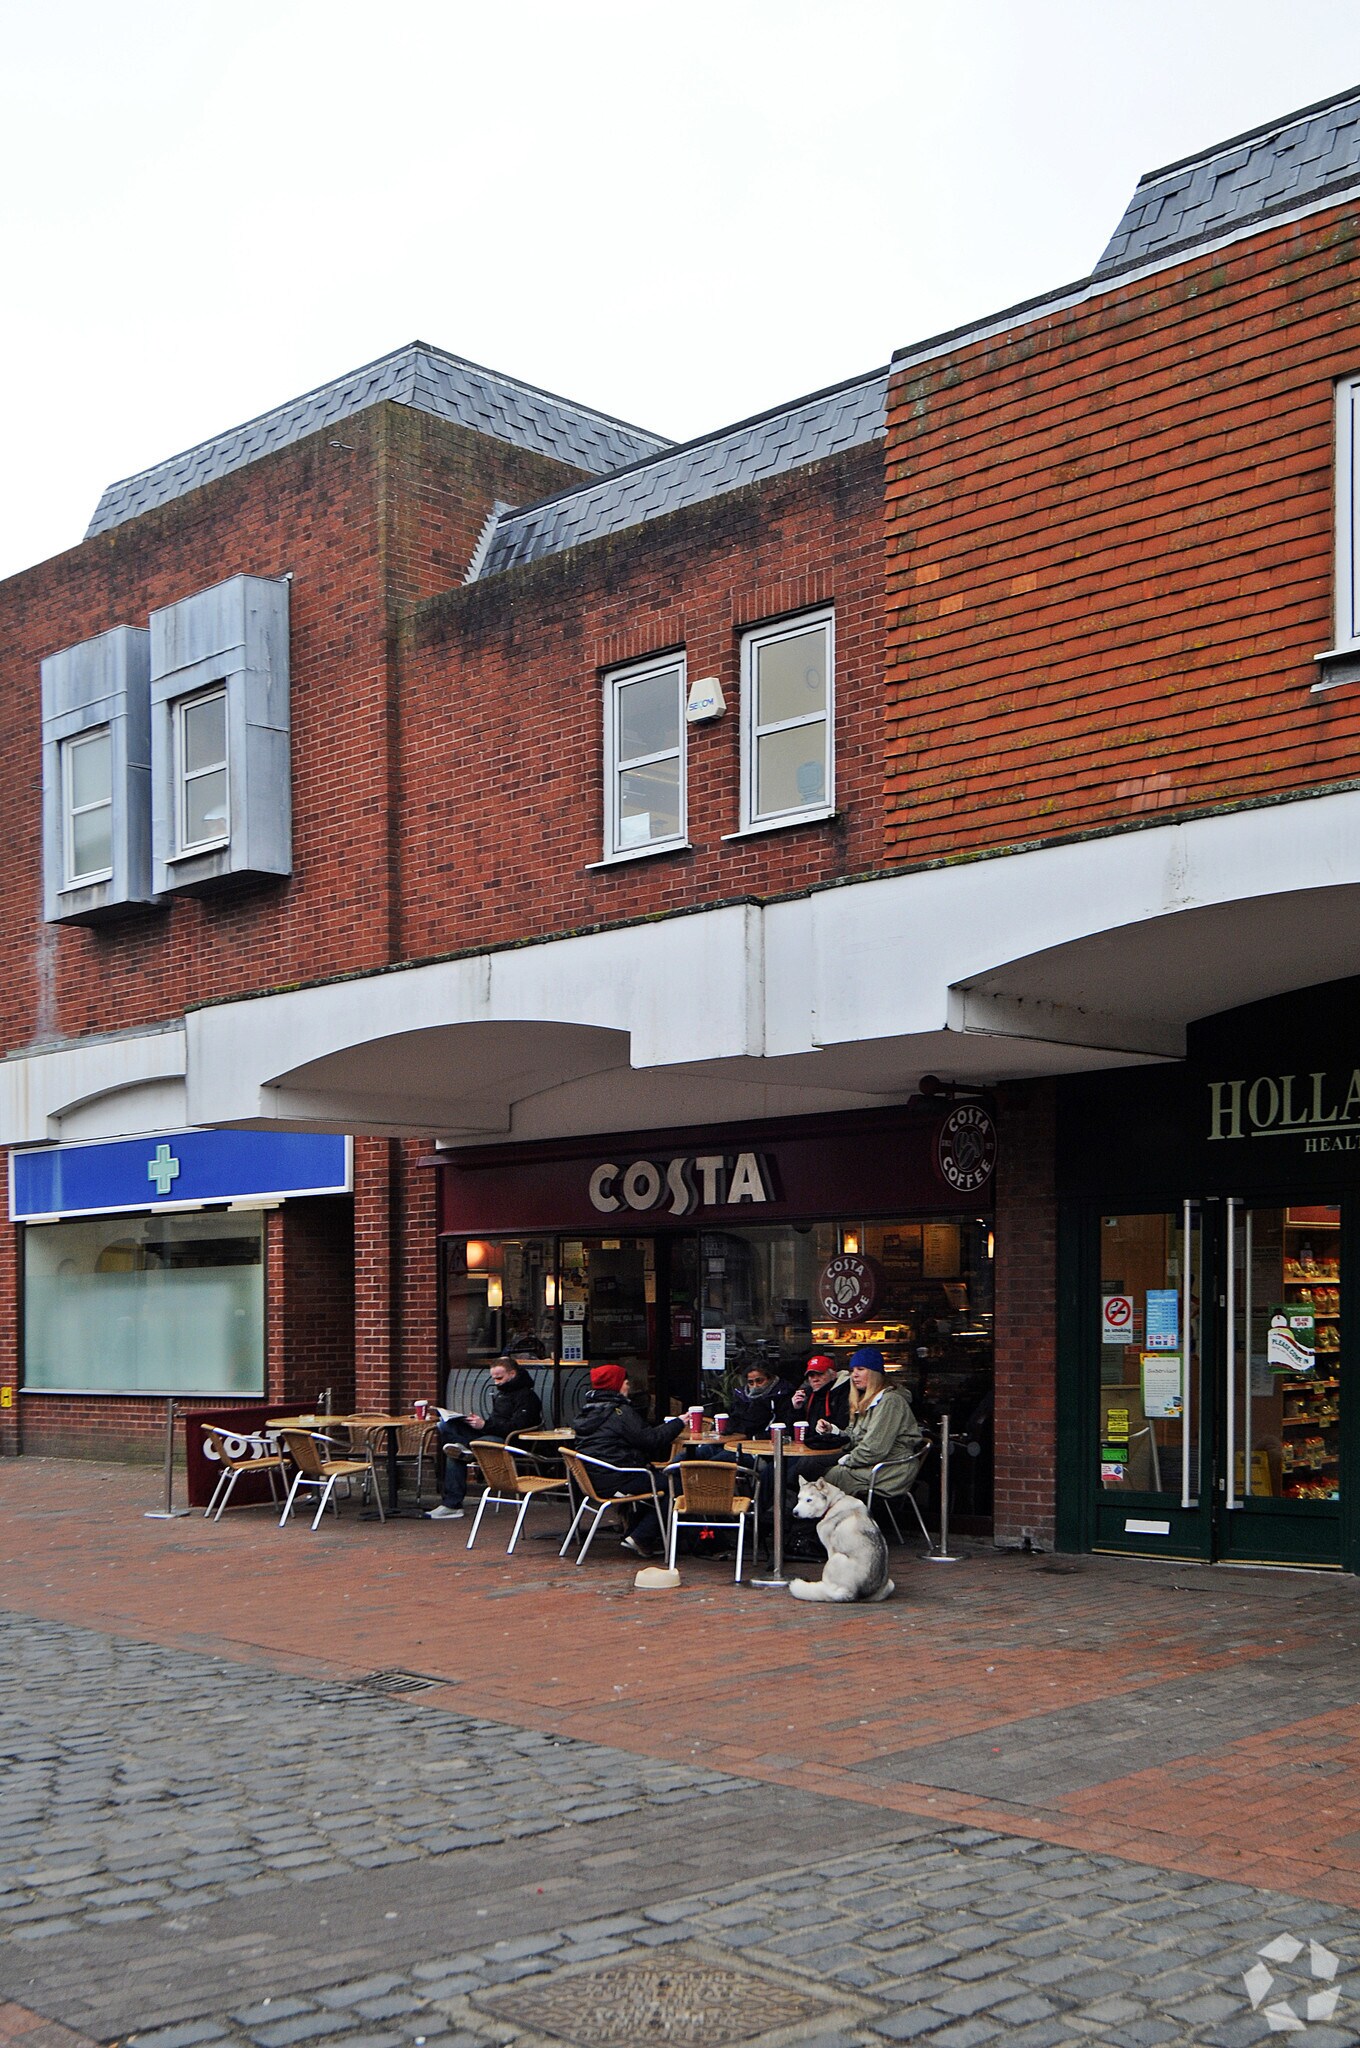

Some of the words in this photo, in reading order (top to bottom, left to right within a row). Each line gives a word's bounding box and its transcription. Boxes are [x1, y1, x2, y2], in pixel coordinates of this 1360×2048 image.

[1206, 1069, 1360, 1141] HOLLA
[948, 1108, 990, 1135] COSTA
[588, 1152, 768, 1216] COSTA
[942, 1156, 991, 1188] COFFEE
[826, 1258, 865, 1278] COSTA
[824, 1295, 870, 1318] COFFEE
[1272, 1338, 1290, 1351] PLEASE
[1289, 1349, 1303, 1363] COME
[203, 1430, 291, 1460] COST
